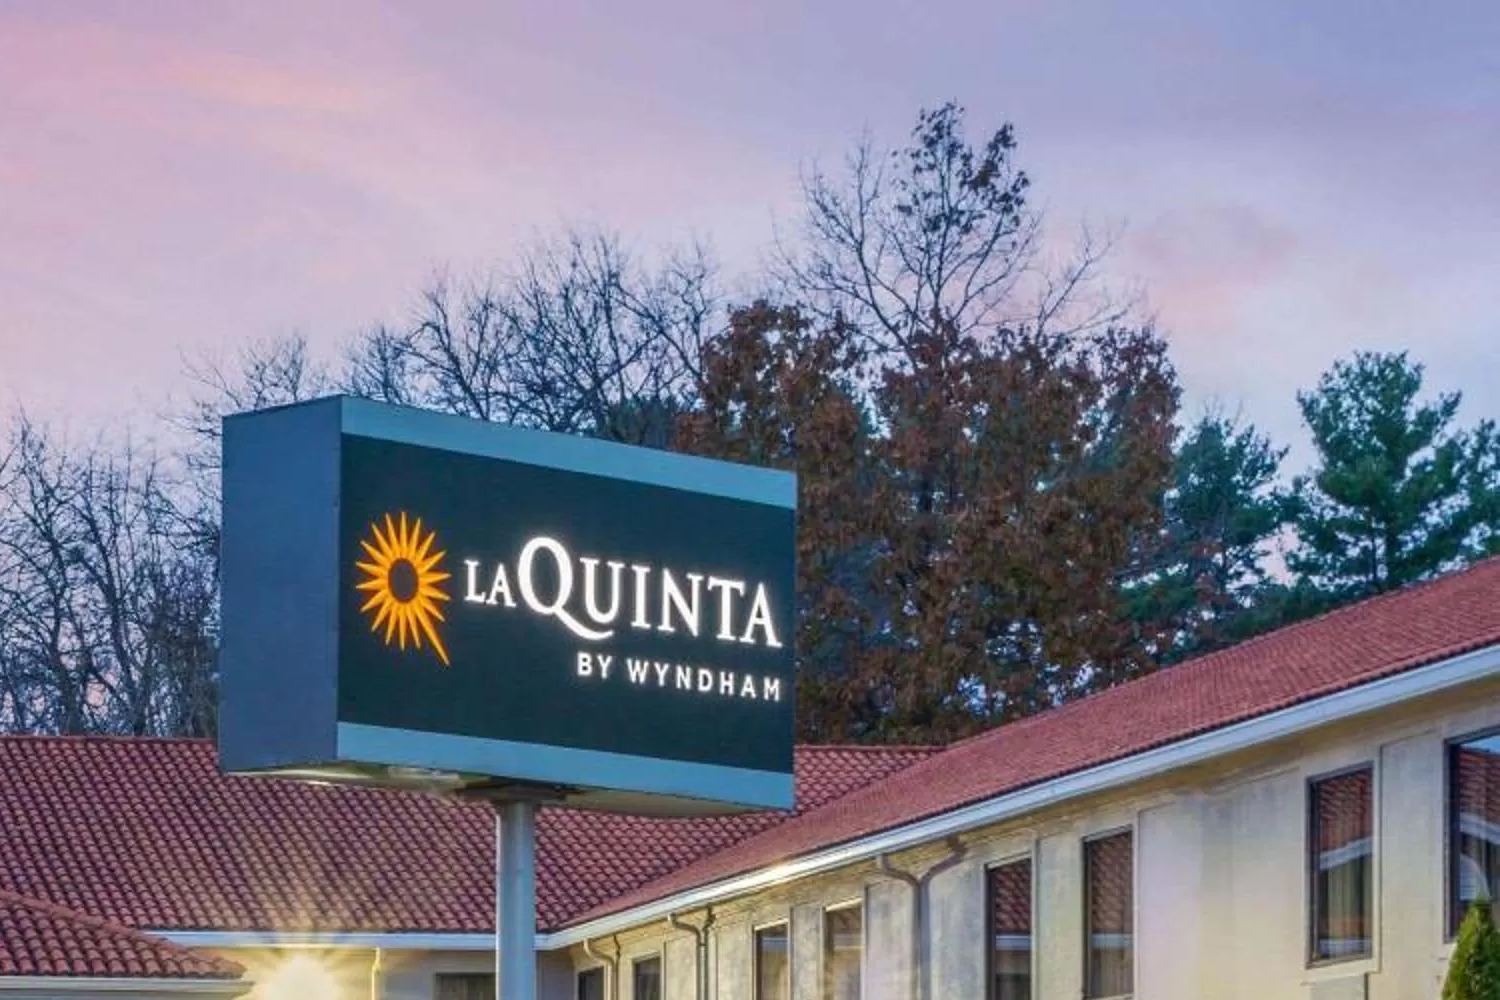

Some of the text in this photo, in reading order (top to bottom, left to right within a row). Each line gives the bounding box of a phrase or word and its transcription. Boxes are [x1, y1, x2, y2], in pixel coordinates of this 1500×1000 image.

[464, 536, 784, 648] LA QUINTA
[577, 651, 781, 702] BY WYNDHAM
